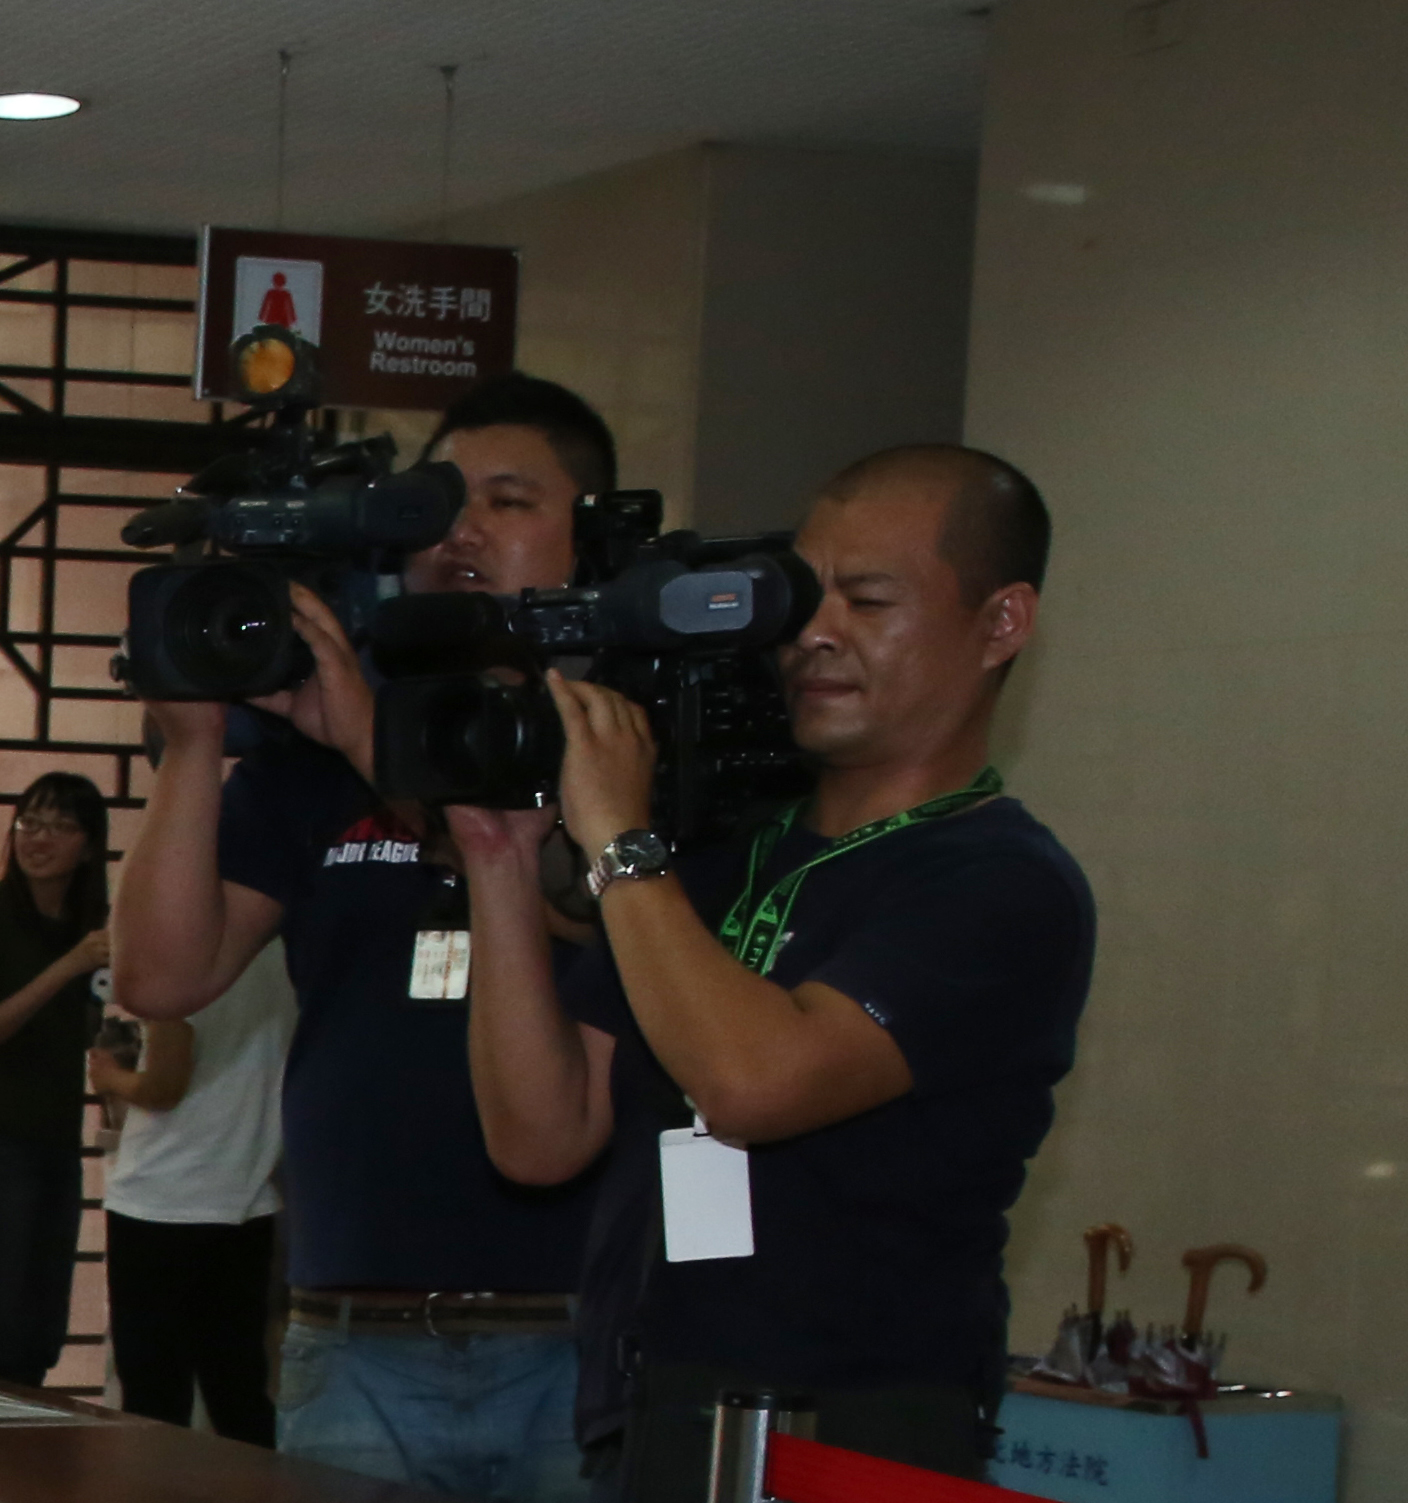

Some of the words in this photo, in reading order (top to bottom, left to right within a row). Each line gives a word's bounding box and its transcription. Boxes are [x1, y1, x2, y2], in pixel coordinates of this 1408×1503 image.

[364, 281, 492, 322] 女洗手間
[373, 330, 475, 356] Women's
[370, 351, 477, 377] Restroom
